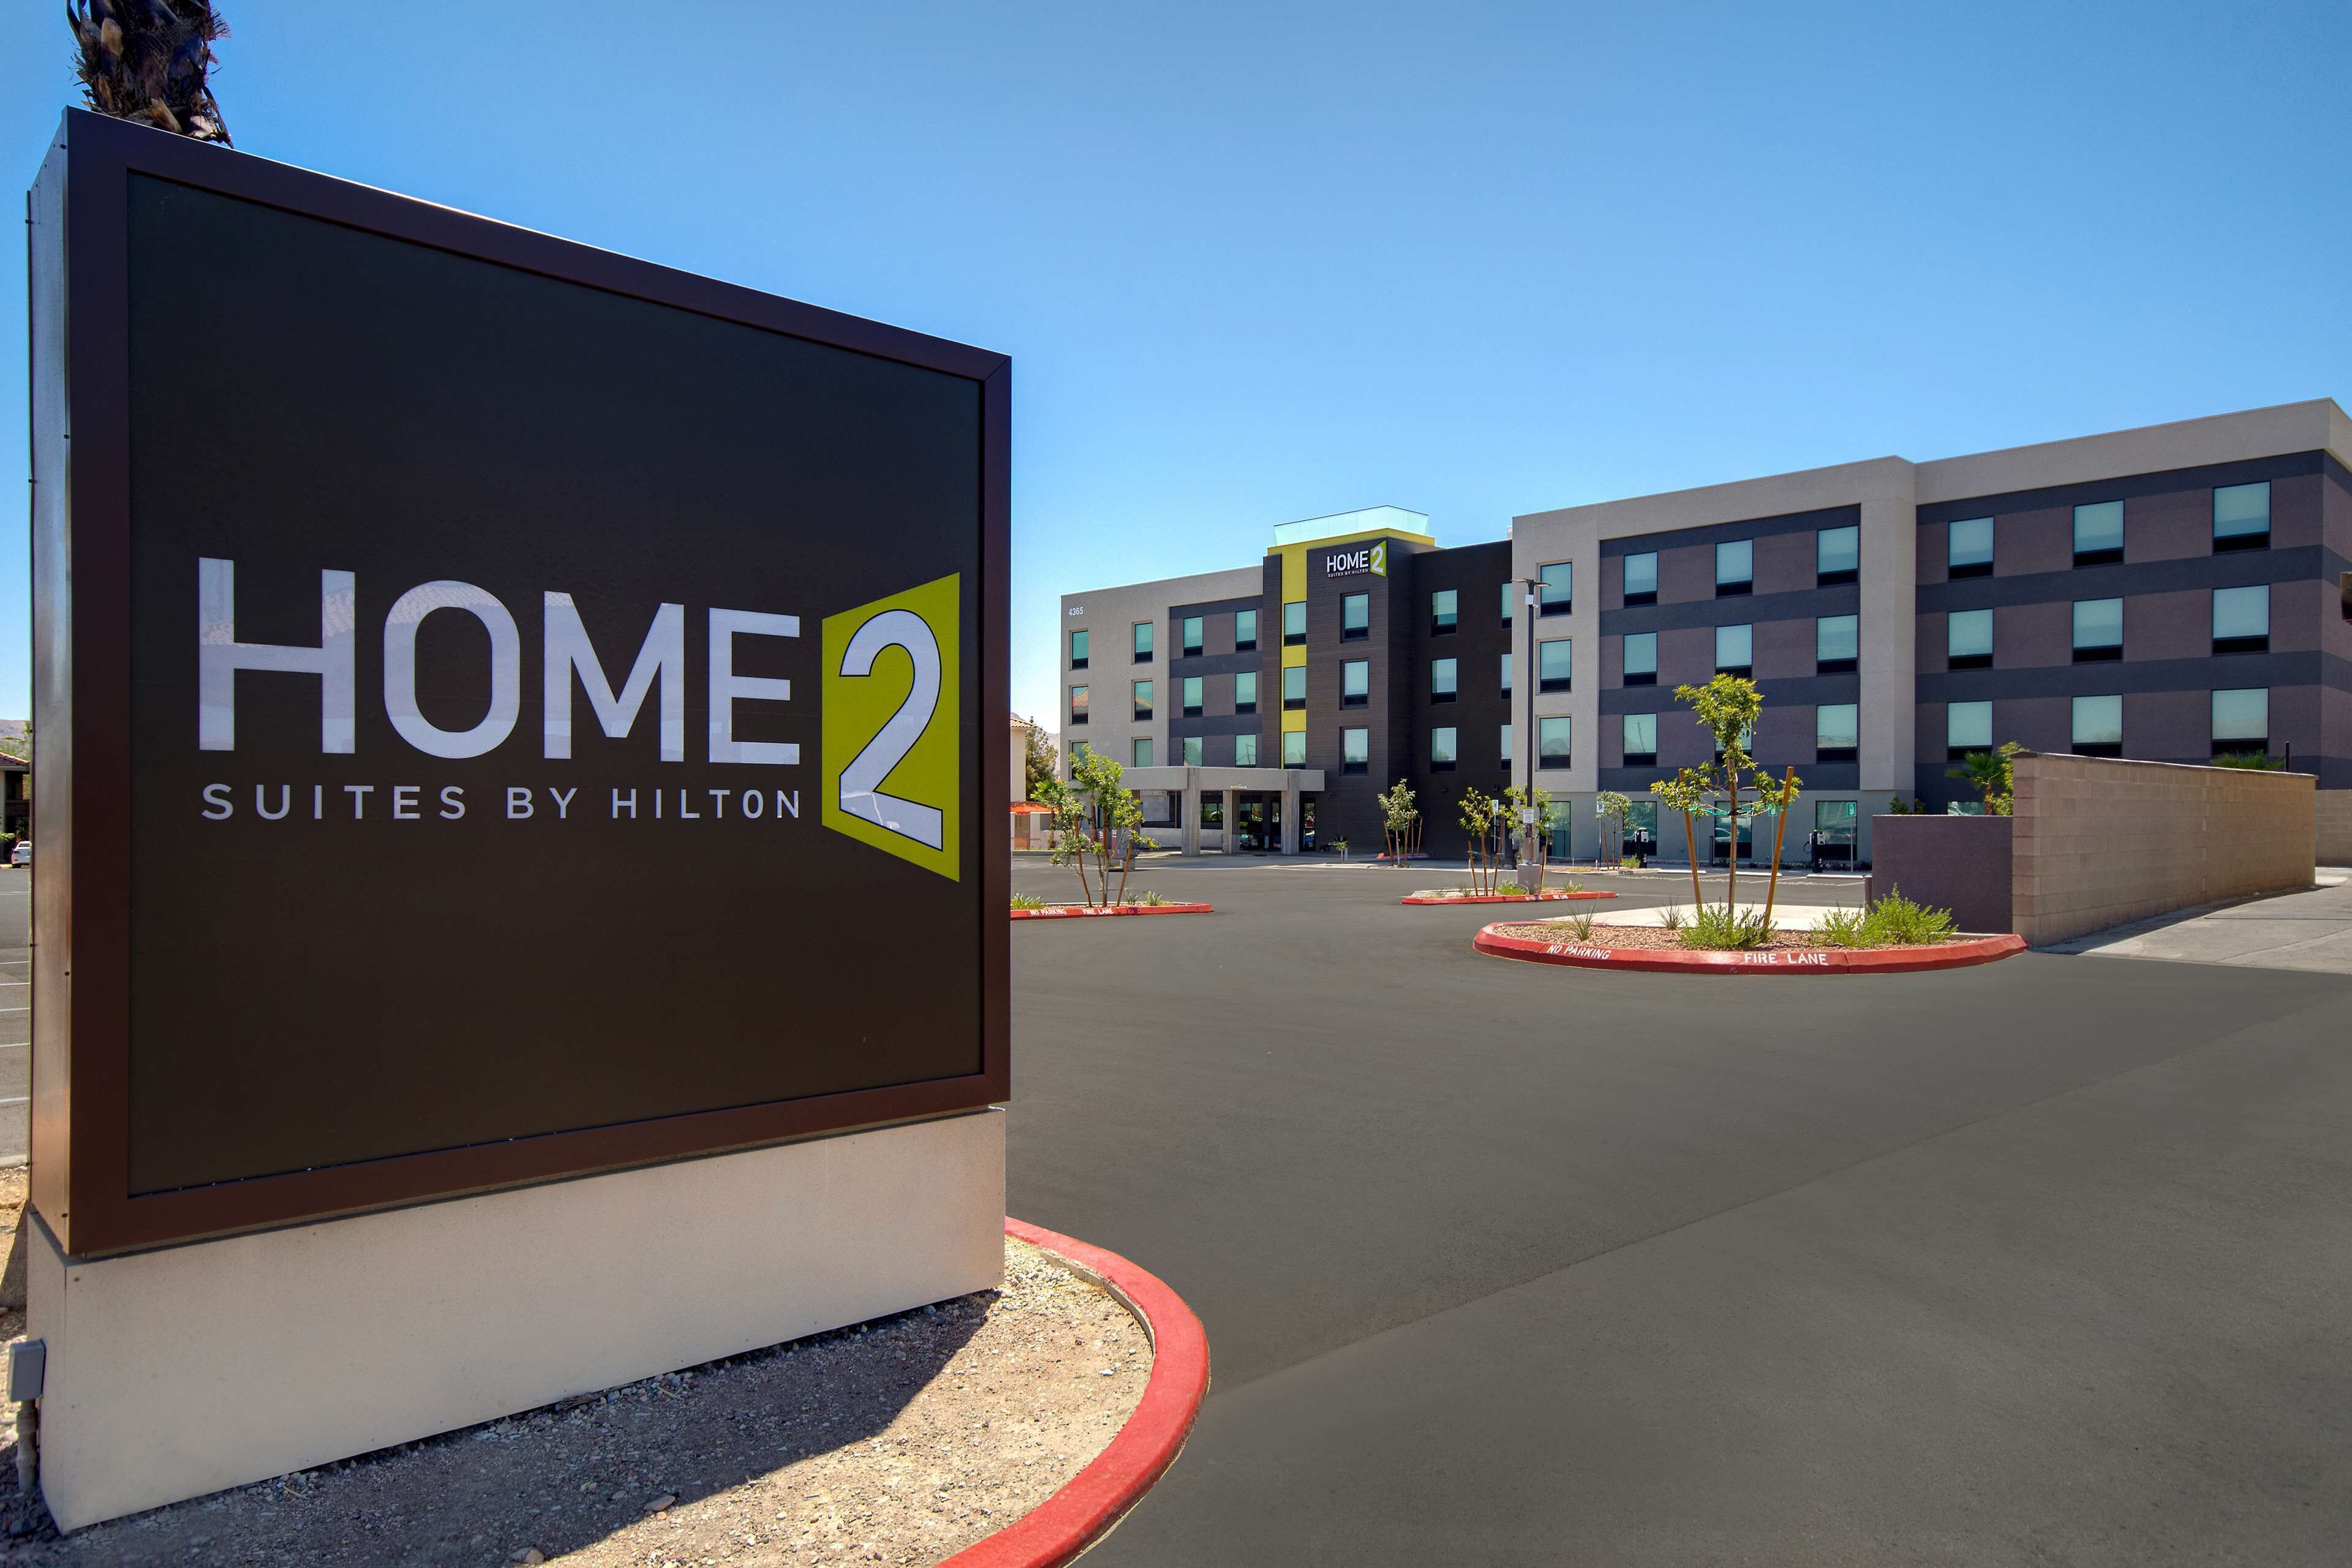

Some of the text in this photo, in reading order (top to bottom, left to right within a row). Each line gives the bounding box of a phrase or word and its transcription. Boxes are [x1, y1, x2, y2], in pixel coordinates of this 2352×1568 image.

[1068, 607, 1084, 616] 4365
[201, 783, 800, 821] SUITES BY HILTON
[1547, 944, 1828, 965] NO PARKING FIRE LANE
